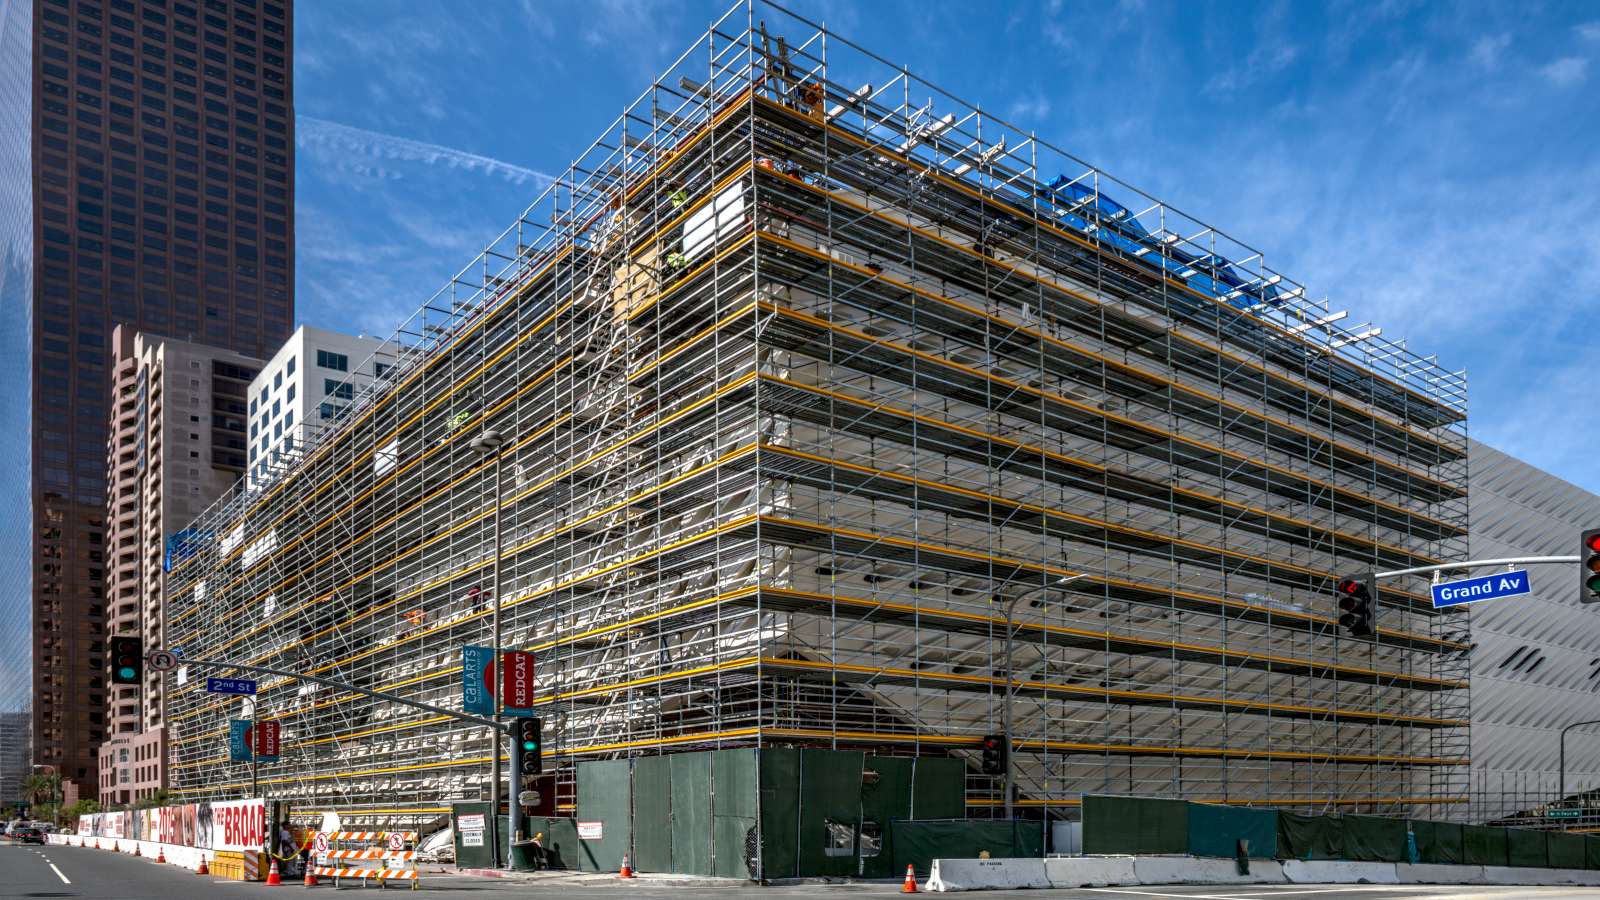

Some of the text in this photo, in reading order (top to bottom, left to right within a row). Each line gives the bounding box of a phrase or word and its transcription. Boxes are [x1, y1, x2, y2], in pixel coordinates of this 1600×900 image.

[1440, 578, 1520, 600] Grand Av
[213, 680, 250, 691] 2nd St
[515, 653, 526, 705] REDCAT
[213, 804, 265, 847] THE BROAD
